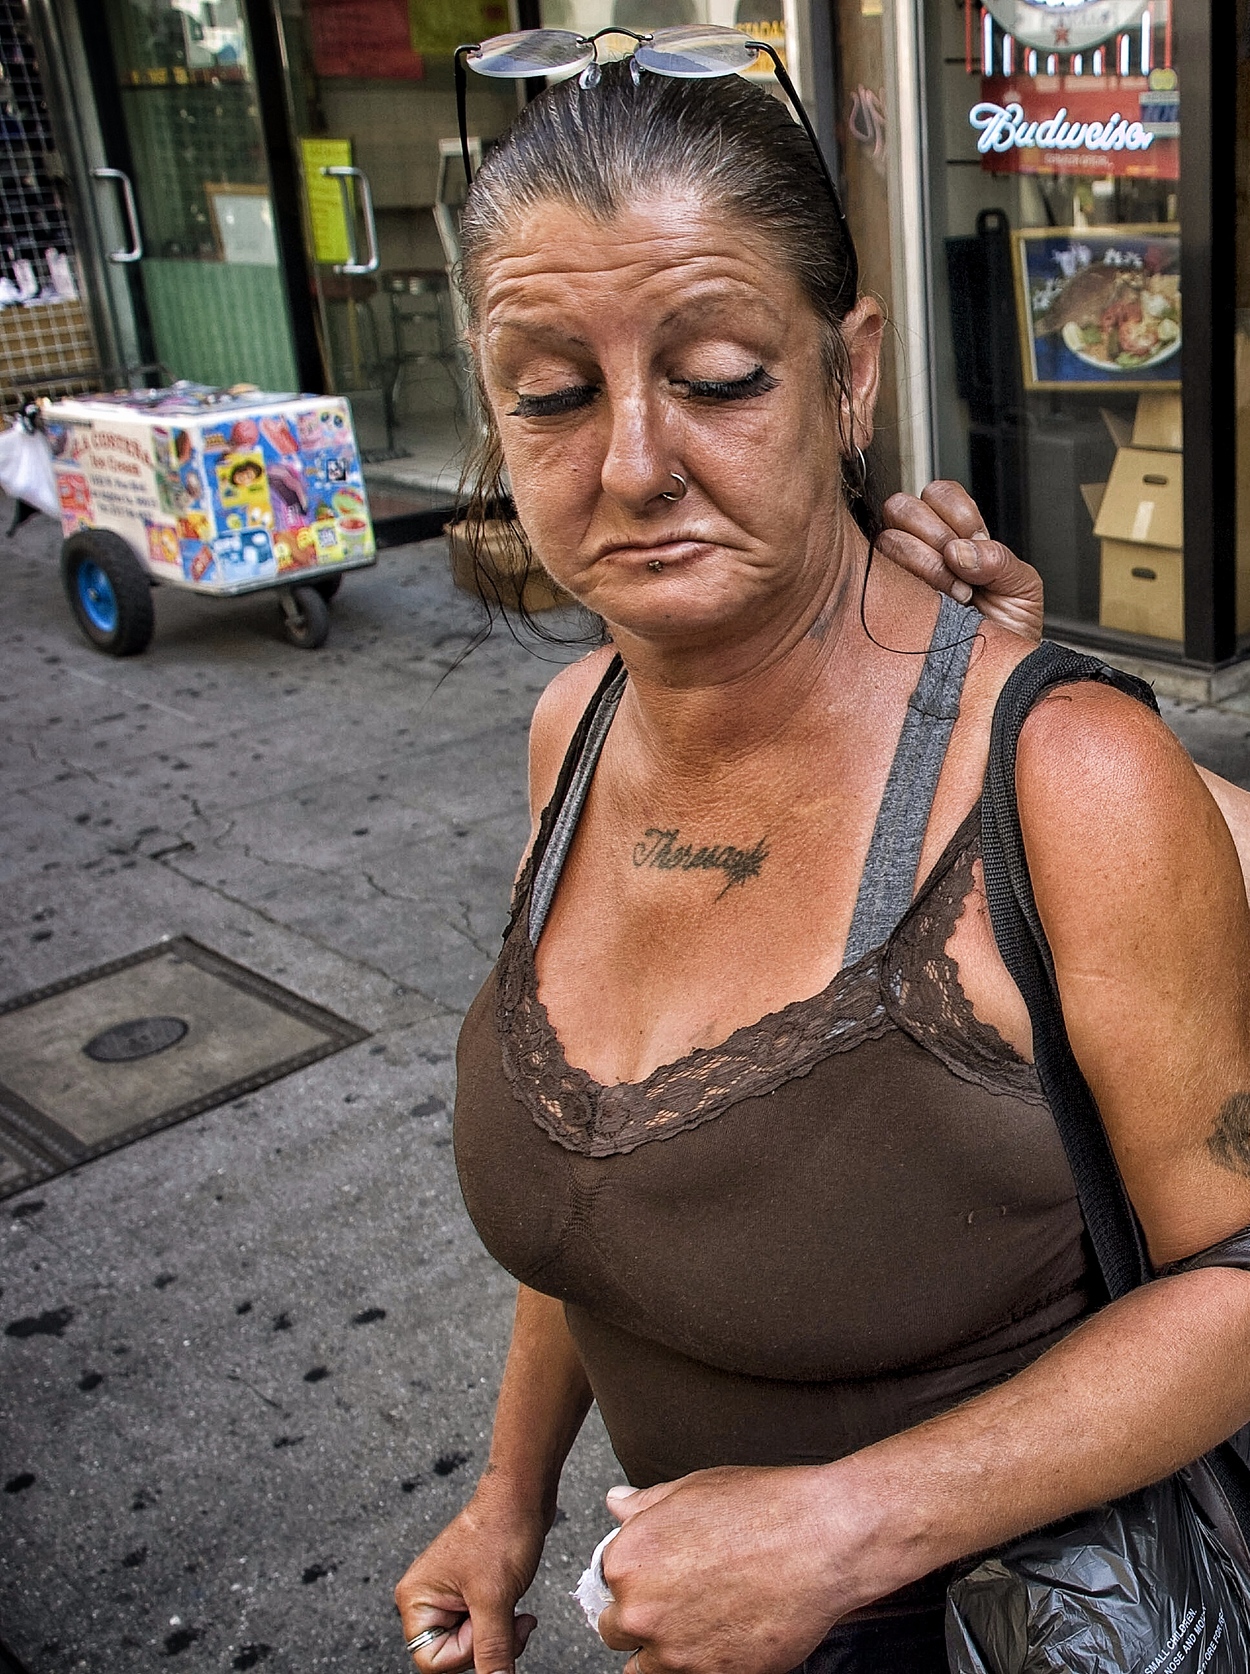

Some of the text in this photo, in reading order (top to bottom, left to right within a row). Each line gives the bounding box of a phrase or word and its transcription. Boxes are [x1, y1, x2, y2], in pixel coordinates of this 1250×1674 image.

[969, 102, 1154, 153] Budweiser
[1144, 1608, 1197, 1674] SMALL CHILDREN.
[1164, 1651, 1185, 1674] NOSE
[1182, 1633, 1196, 1654] AND
[1213, 1624, 1222, 1644] FOR
